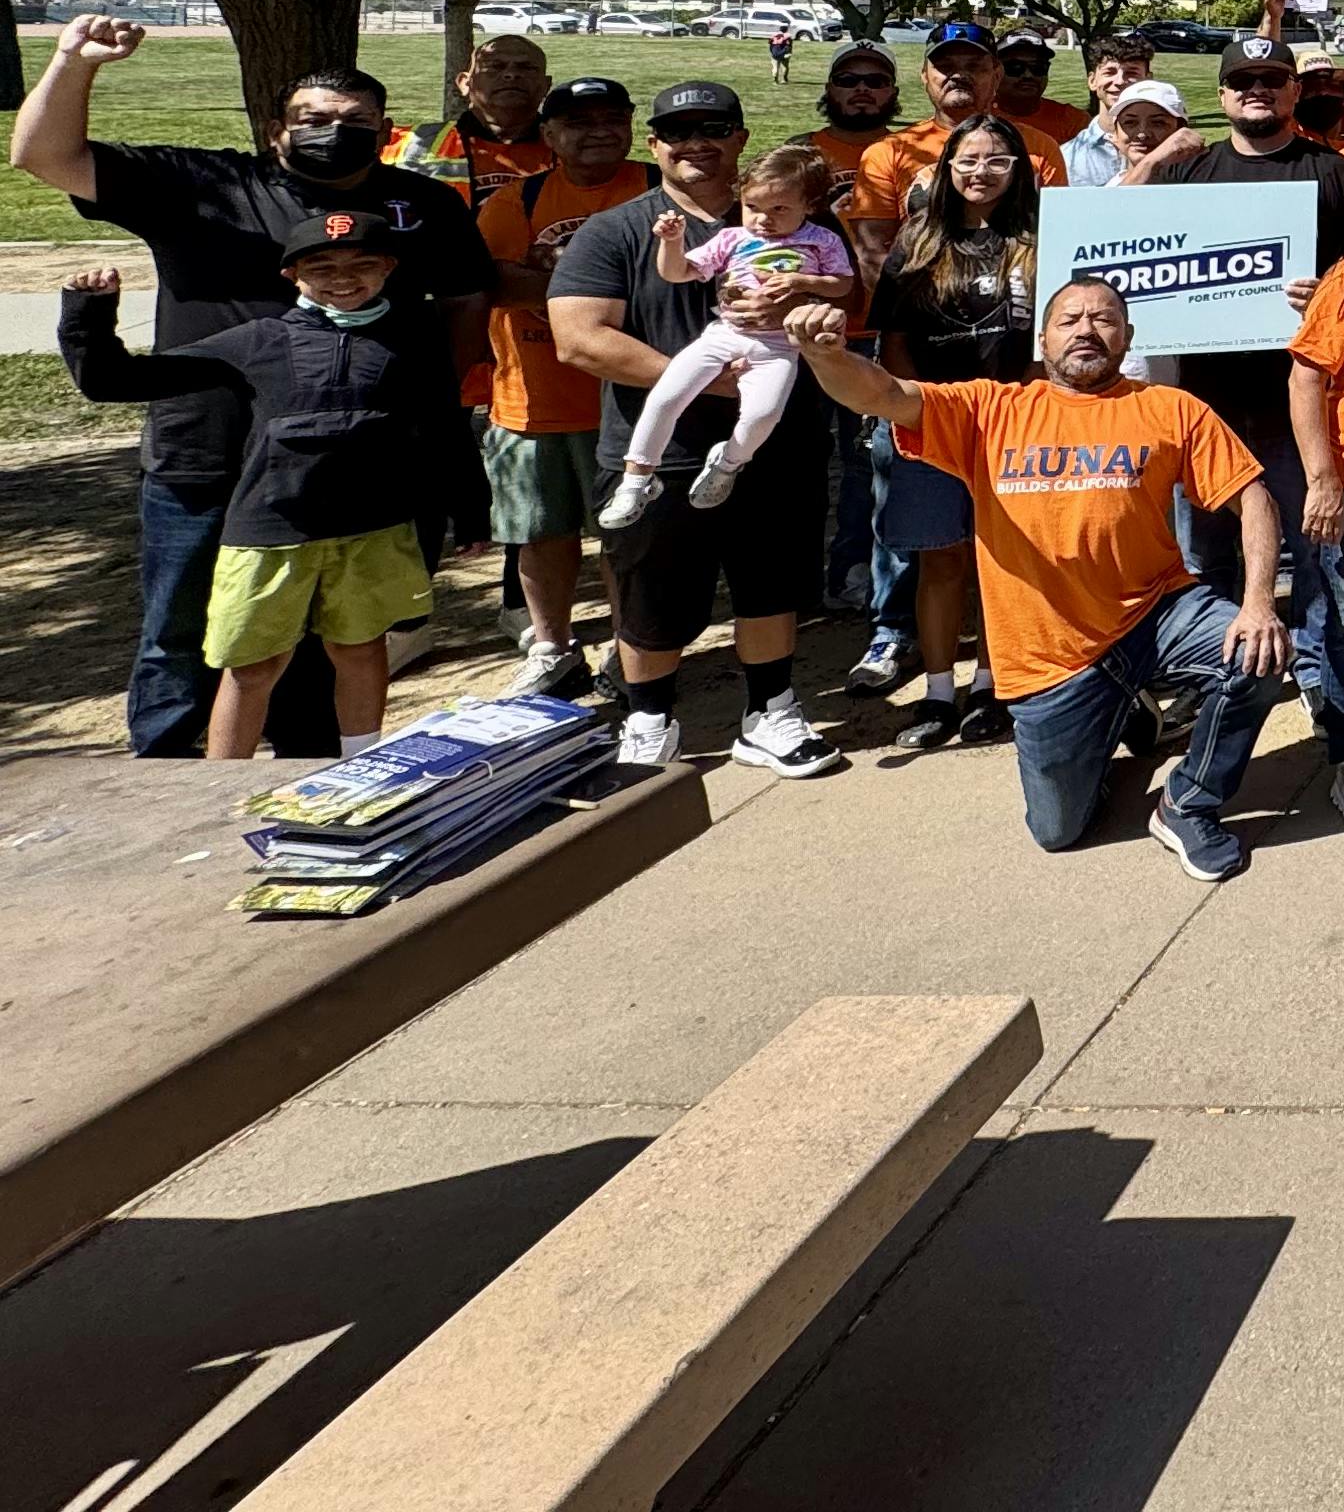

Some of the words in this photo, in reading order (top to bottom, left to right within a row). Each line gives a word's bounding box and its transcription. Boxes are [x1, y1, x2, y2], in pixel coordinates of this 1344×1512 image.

[1073, 233, 1188, 262] ANTHONY
[1188, 293, 1210, 304] FOR
[1212, 289, 1237, 301] CITY
[1238, 284, 1285, 297] COUNCIL
[996, 480, 1049, 494] BUILDS
[1053, 477, 1141, 492] CALIFORNIA
